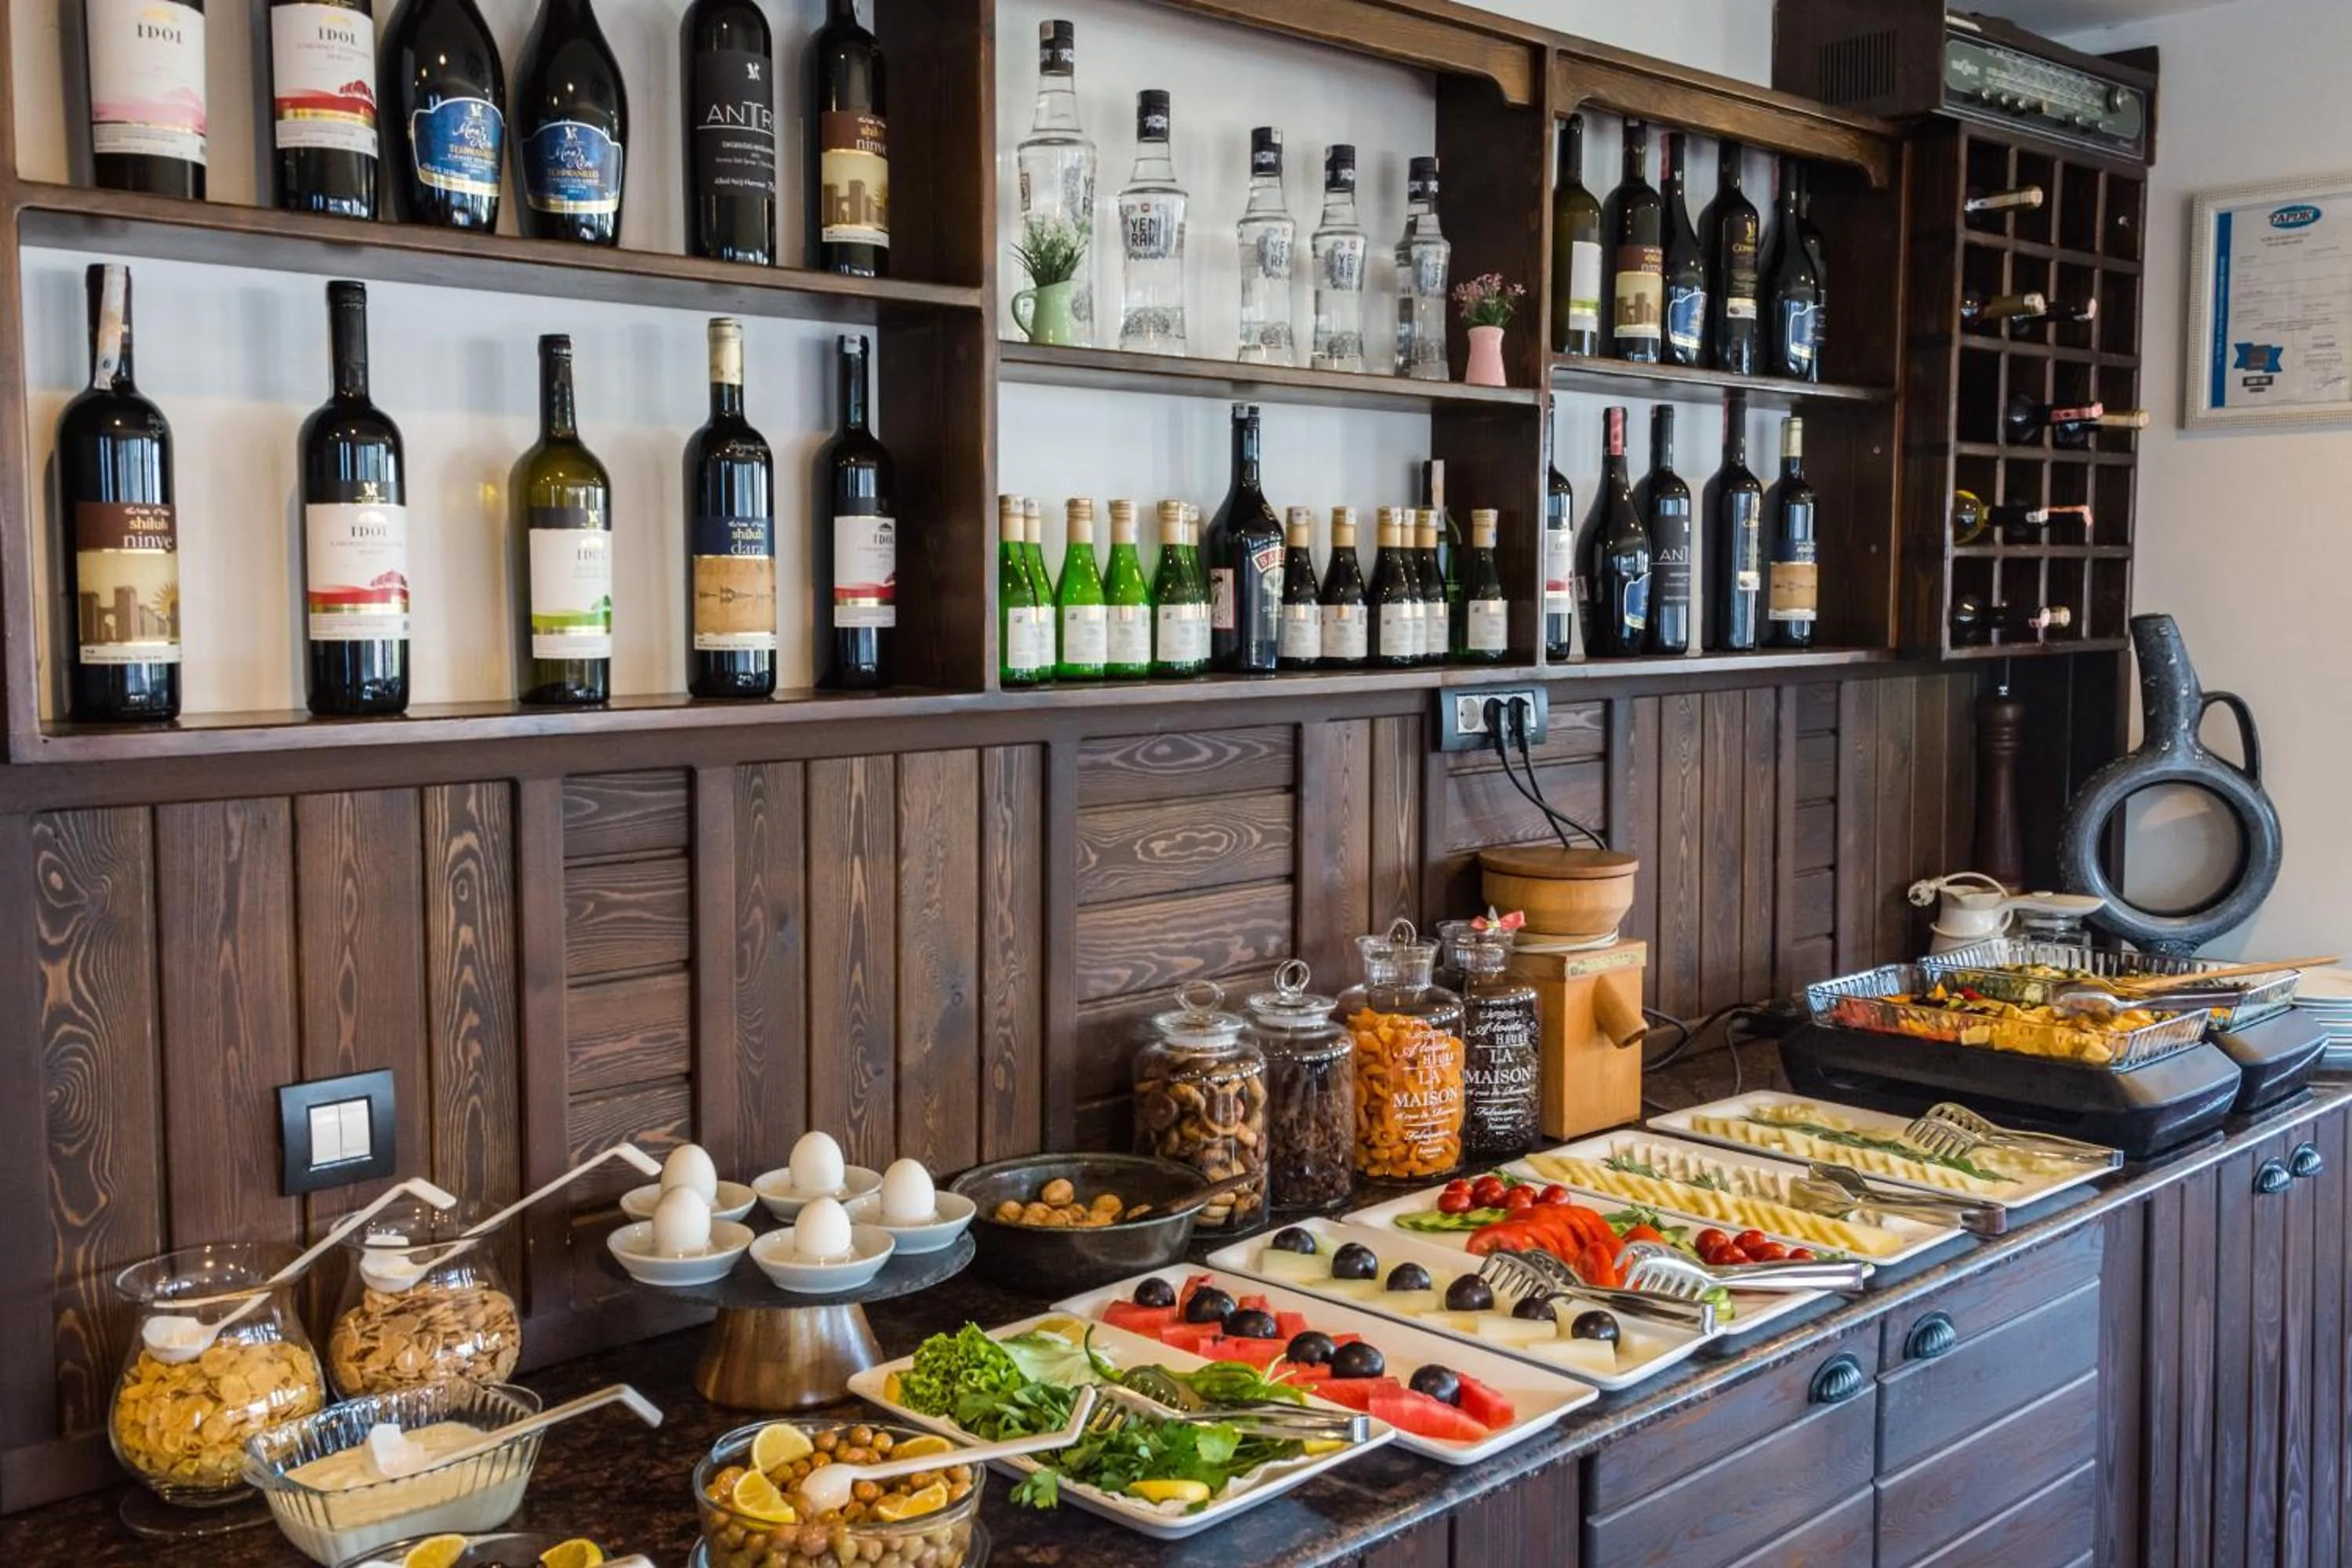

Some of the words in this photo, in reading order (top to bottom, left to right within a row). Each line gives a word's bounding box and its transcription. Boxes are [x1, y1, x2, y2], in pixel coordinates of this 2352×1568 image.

[1490, 1048, 1514, 1063] LA
[1418, 1069, 1442, 1086] LA
[1465, 1067, 1531, 1084] MAISON
[1392, 1087, 1458, 1108] MAISON
